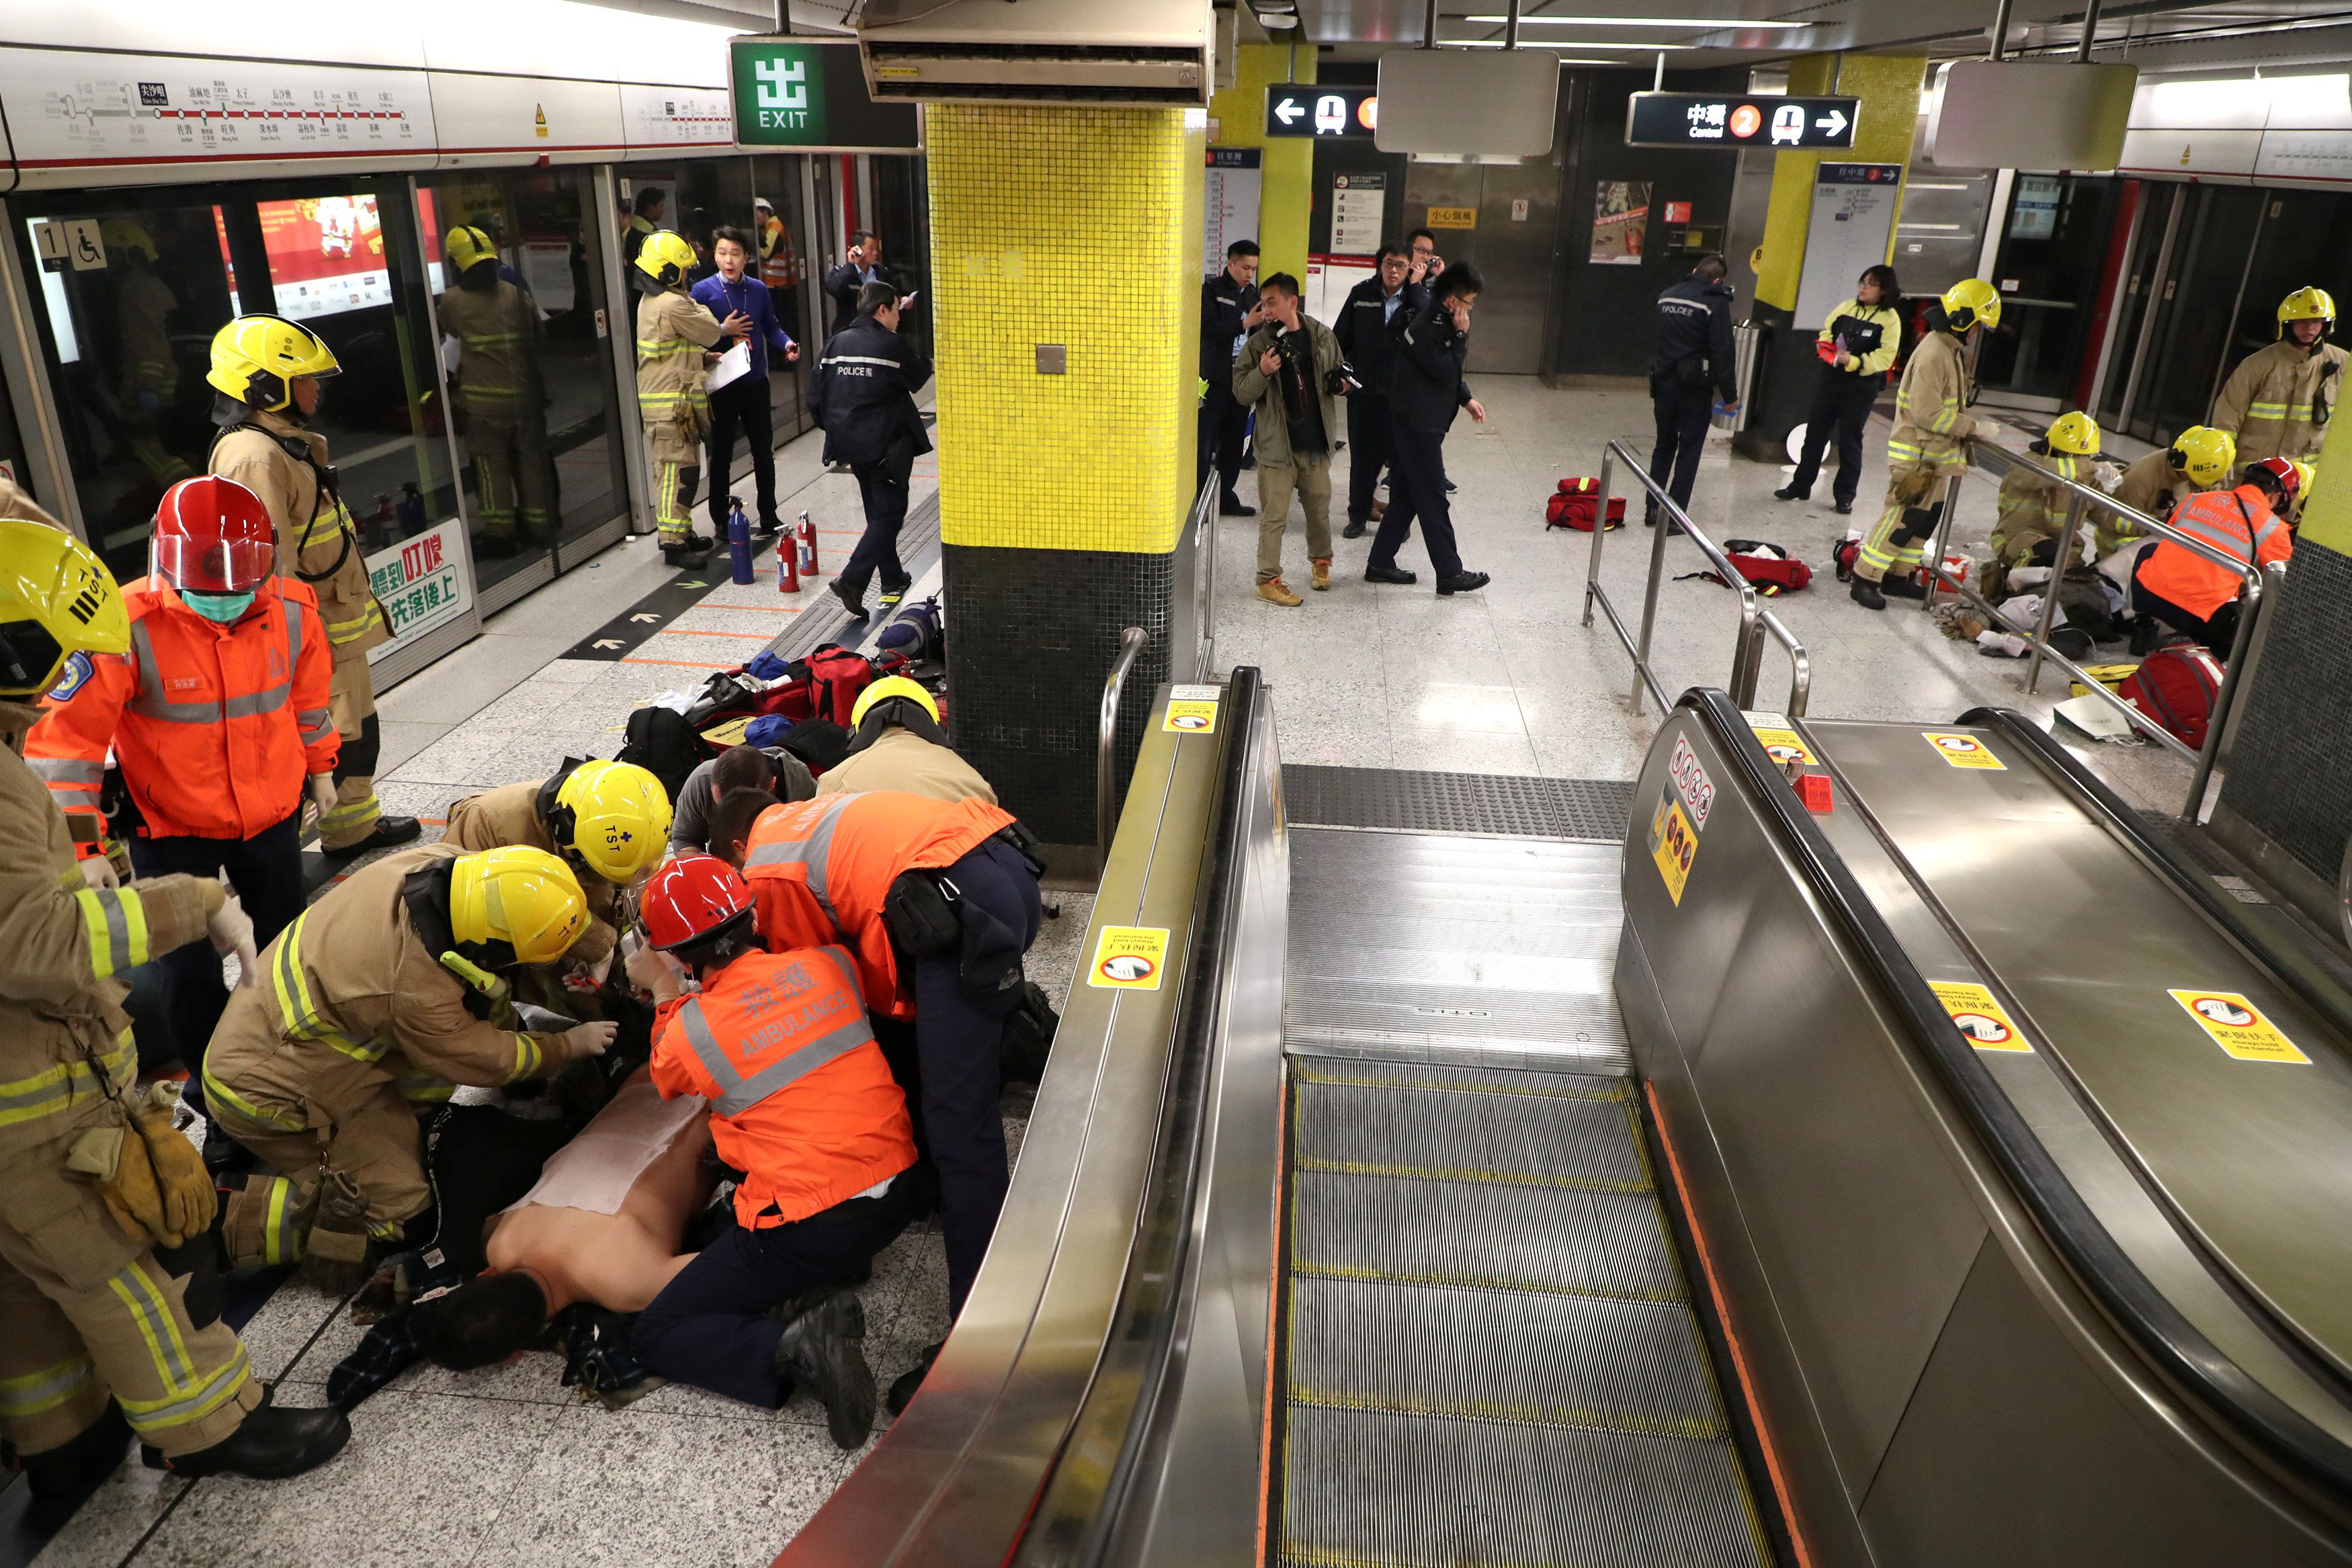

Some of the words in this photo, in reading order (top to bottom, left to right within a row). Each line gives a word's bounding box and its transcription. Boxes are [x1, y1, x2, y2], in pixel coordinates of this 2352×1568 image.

[141, 85, 165, 97] 尖沙咀
[189, 87, 210, 97] 油麻地
[237, 88, 248, 98] 太子
[273, 89, 291, 99] 長沙灣
[759, 111, 807, 128] EXIT
[1687, 103, 1726, 126] 中環
[1736, 110, 1753, 133] 2
[177, 124, 193, 134] 佐敦
[221, 124, 235, 134] 旺角
[259, 124, 278, 134] 深水埗
[298, 124, 315, 133] 荔枝角
[1689, 126, 1724, 138] Central
[1871, 171, 1877, 179] 2
[44, 228, 56, 253] 1
[1756, 249, 1762, 260] B
[1664, 306, 1687, 314] POLICE
[838, 366, 865, 376] POLICE
[79, 568, 108, 603] TST
[386, 575, 456, 629] 先落後上
[1809, 789, 1829, 800] 停機
[605, 825, 620, 851] TST
[738, 961, 818, 1018] 救護
[1948, 1000, 1994, 1009] 緊握扶
[741, 990, 849, 1059] AMBULANCE
[2215, 1031, 2279, 1041] 緊握扶手
